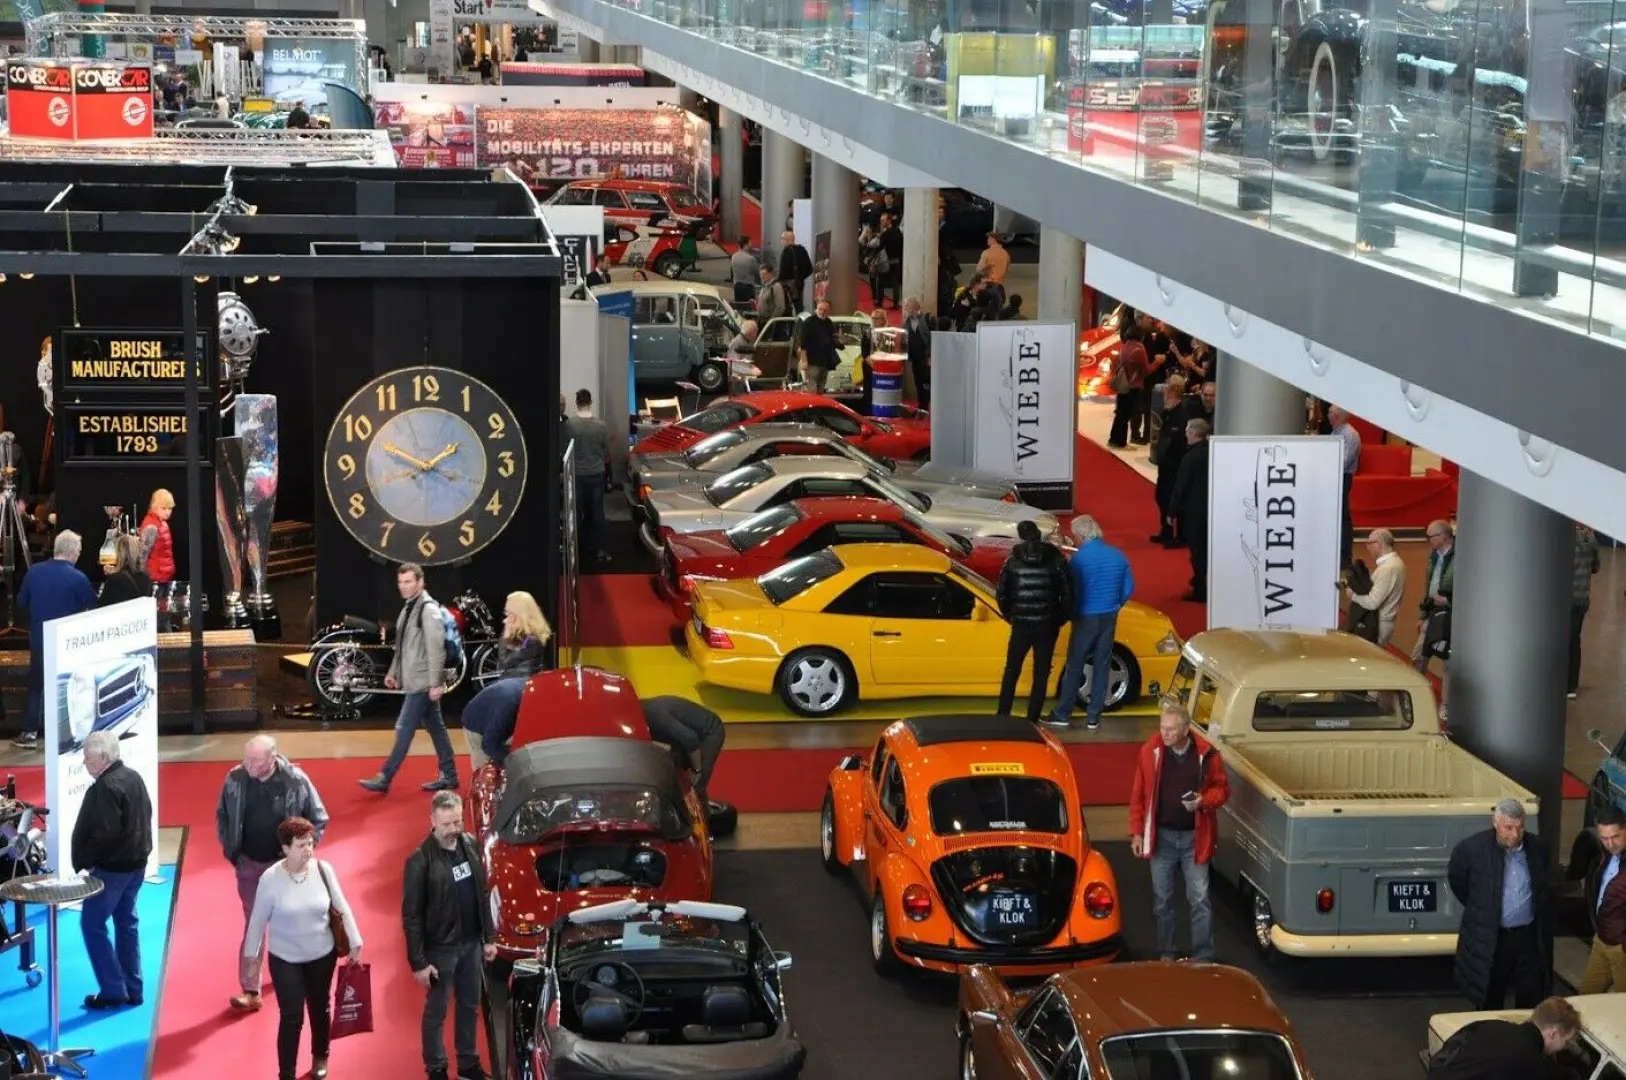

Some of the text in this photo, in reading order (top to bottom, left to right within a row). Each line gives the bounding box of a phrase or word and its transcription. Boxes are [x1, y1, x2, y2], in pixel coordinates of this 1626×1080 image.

[486, 119, 514, 134] DIE
[619, 163, 675, 178] AHREN
[110, 340, 162, 358] BRUSH
[72, 360, 201, 378] MANUFACTURE
[376, 384, 397, 411] 11
[412, 375, 441, 402] 12
[461, 385, 471, 412] 1
[1016, 341, 1041, 463] WIEBE
[343, 414, 373, 442] 10
[488, 412, 506, 439] 2
[116, 435, 159, 453] 1793
[336, 454, 357, 481] 9
[497, 451, 516, 478] 3
[348, 492, 366, 519] 8
[484, 489, 503, 516] 4
[380, 521, 396, 548] 7
[417, 531, 437, 557] 6
[458, 519, 476, 546] 5
[1264, 462, 1297, 617] WIEBE
[1023, 897, 1032, 909] &
[1392, 884, 1431, 896] KIEFT &
[999, 911, 1026, 924] KLOK
[1399, 898, 1425, 910] KLOK
